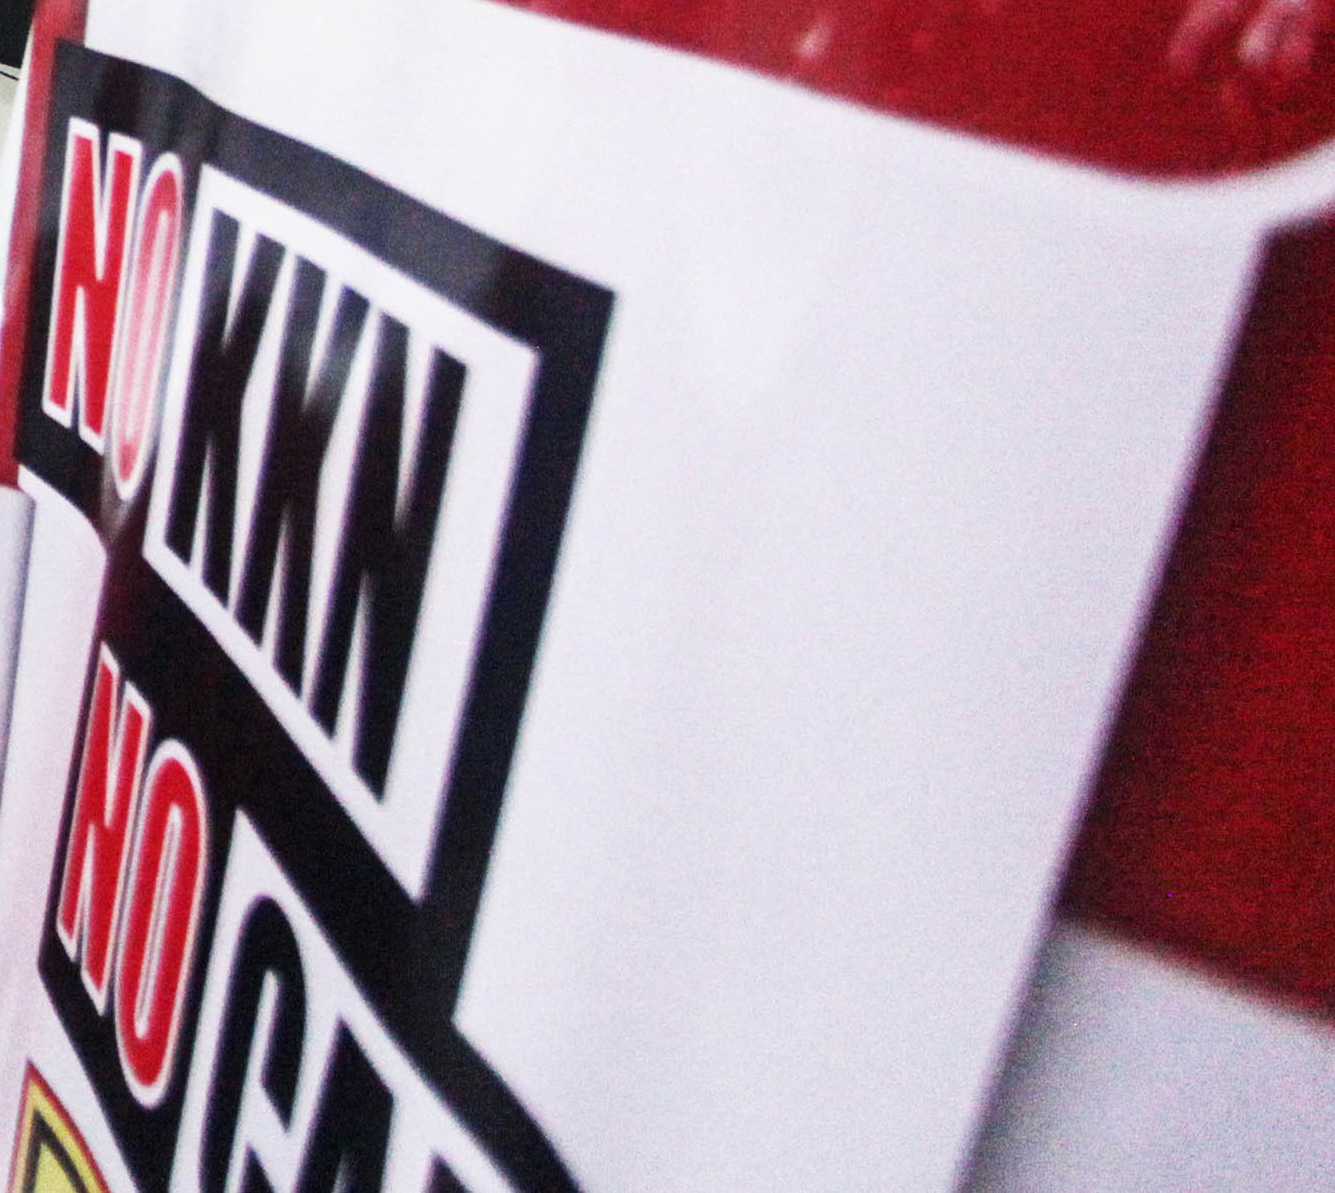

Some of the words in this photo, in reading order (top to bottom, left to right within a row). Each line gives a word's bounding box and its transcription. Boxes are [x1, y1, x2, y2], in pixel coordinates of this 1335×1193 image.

[44, 117, 184, 503] NO
[163, 206, 468, 804] KKN
[55, 640, 209, 1106] NO
